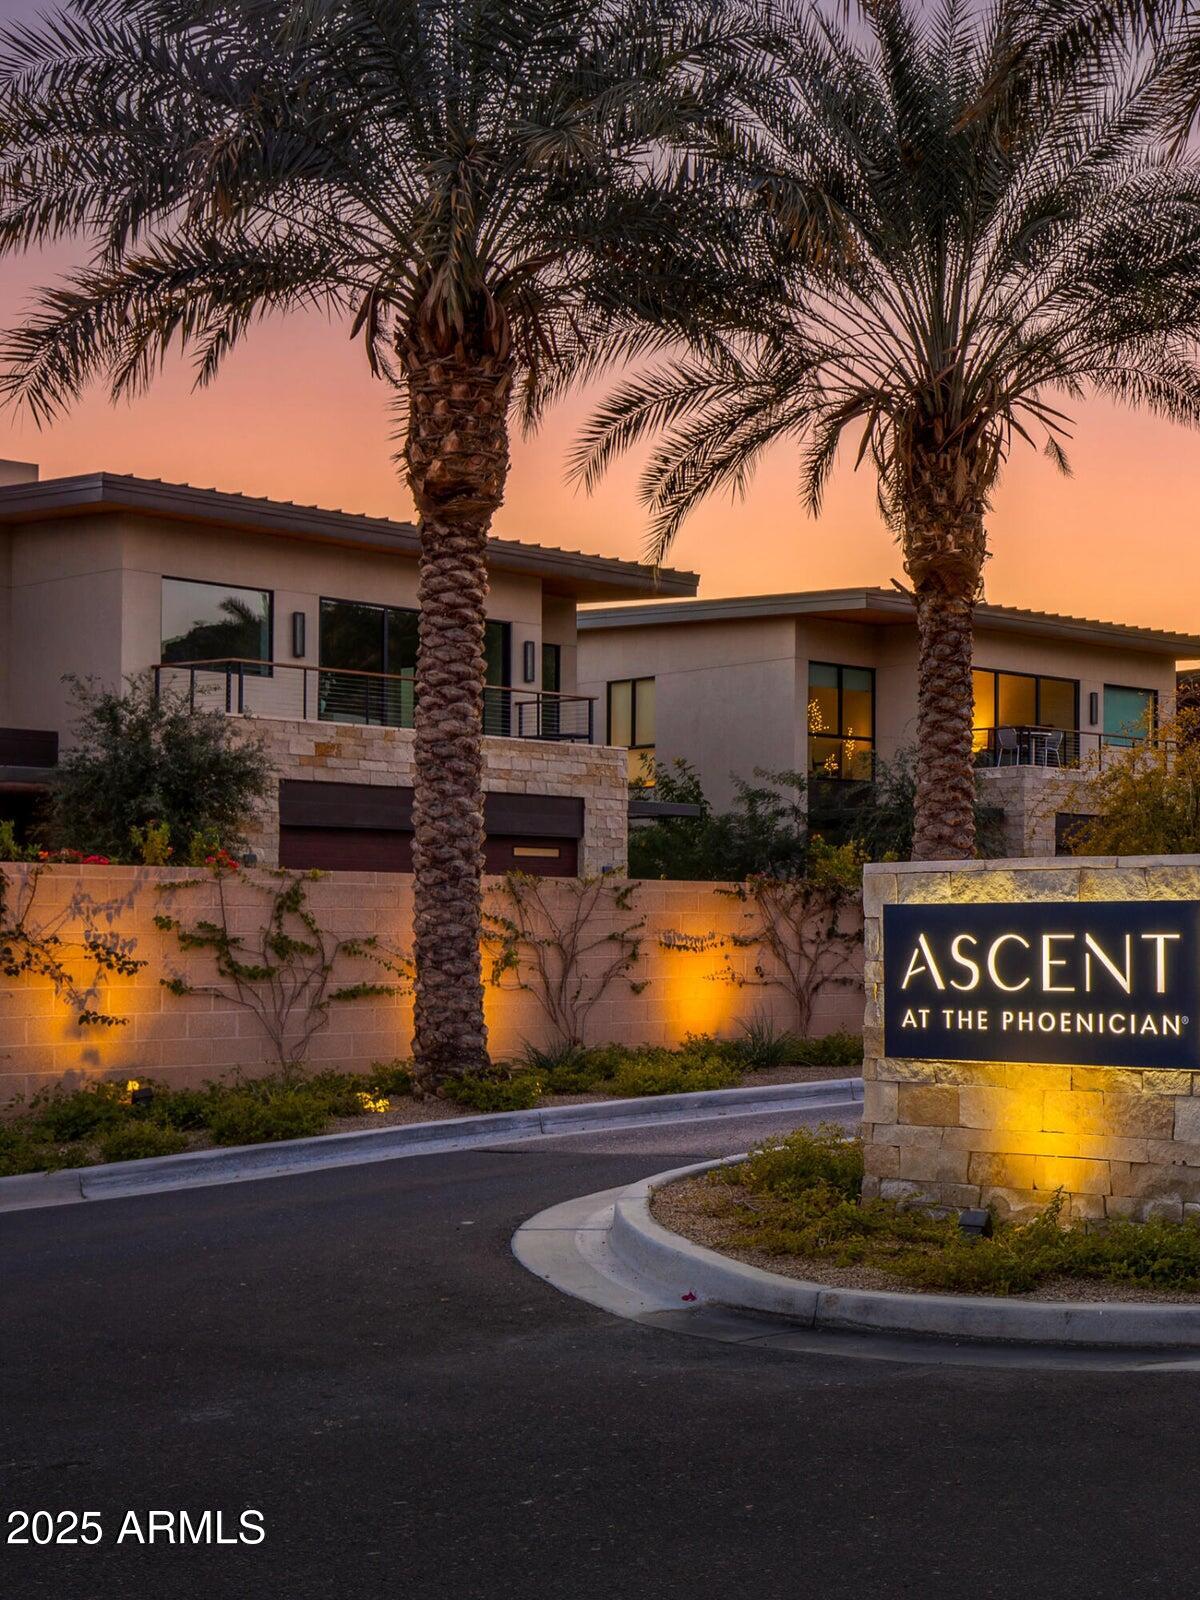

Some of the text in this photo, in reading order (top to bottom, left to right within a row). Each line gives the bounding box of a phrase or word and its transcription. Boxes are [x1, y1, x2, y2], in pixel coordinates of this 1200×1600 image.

[900, 932, 1181, 995] ASCENT
[901, 1008, 931, 1029] AT
[941, 1009, 989, 1031] THE
